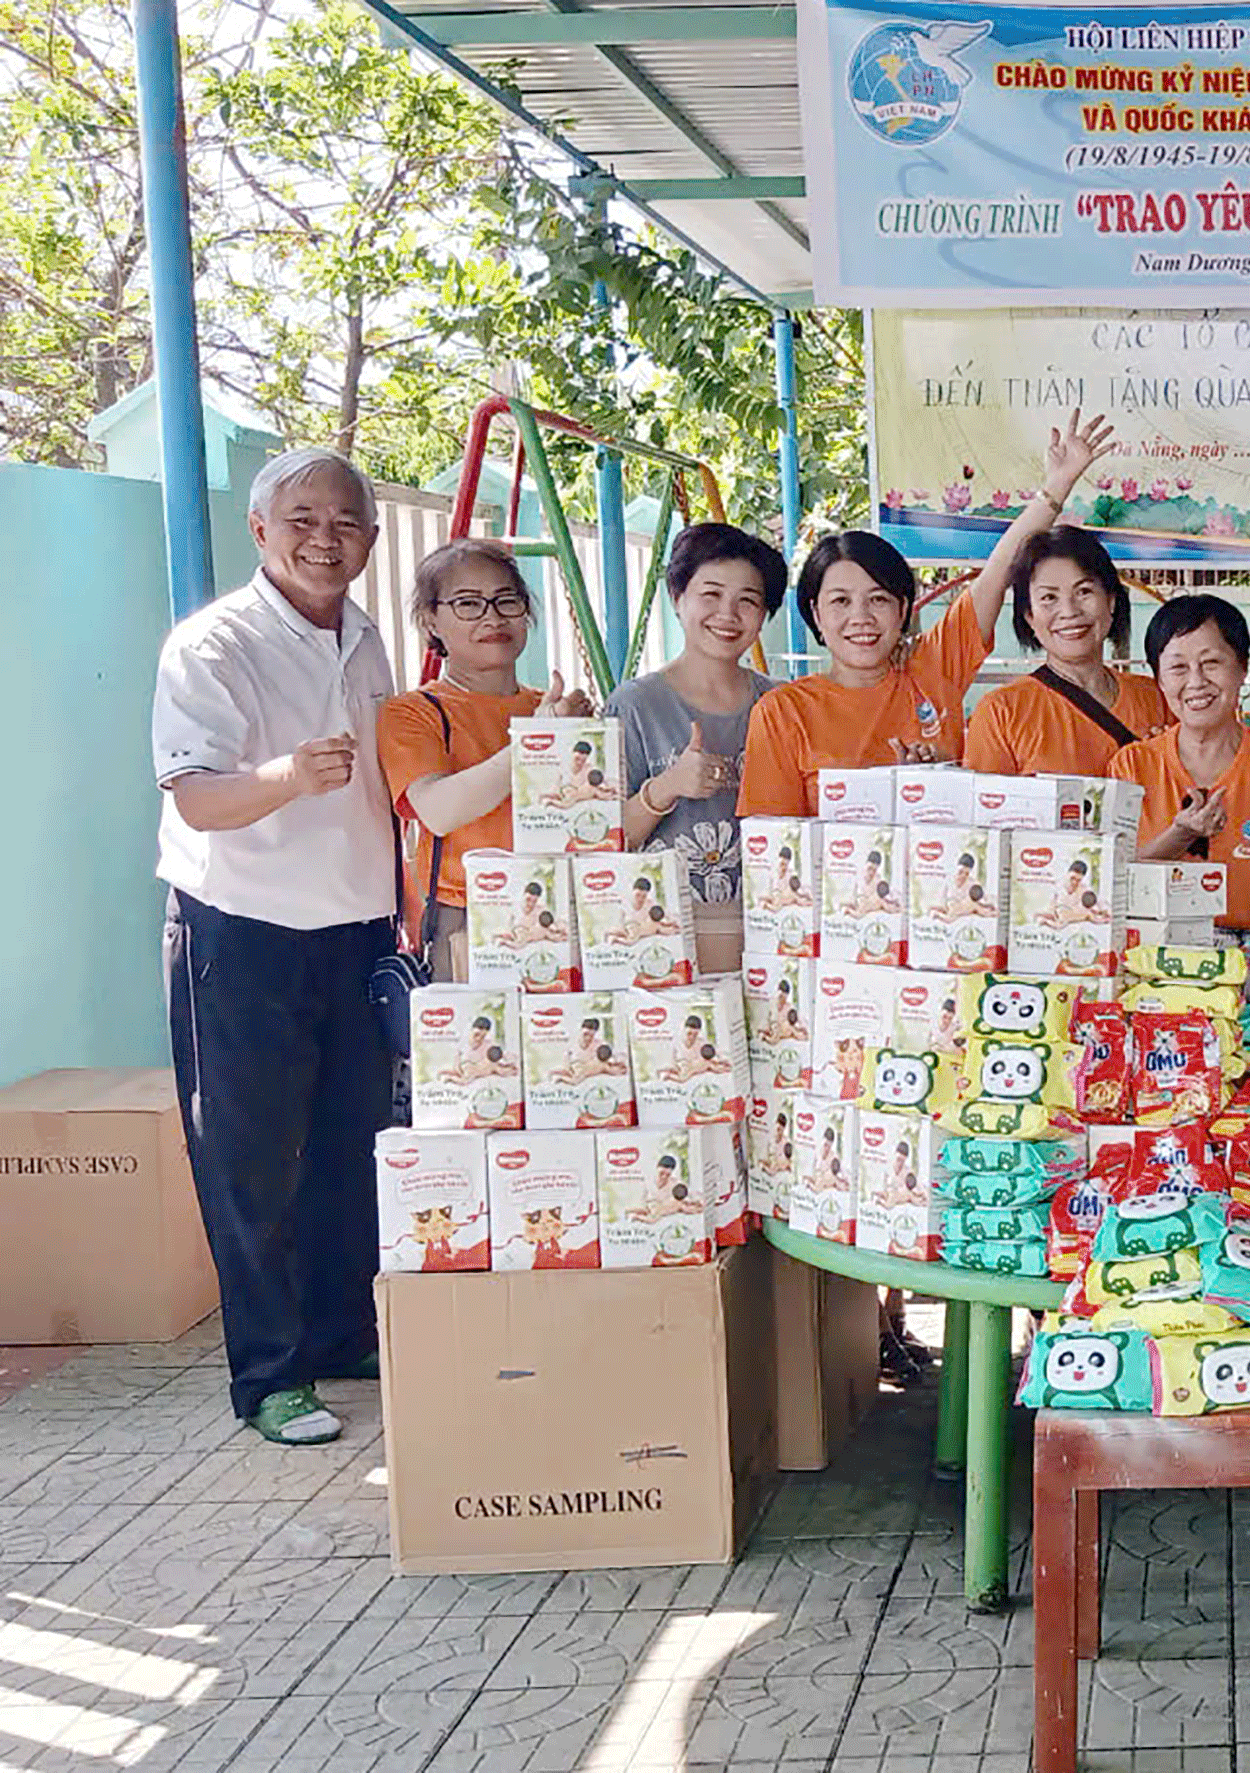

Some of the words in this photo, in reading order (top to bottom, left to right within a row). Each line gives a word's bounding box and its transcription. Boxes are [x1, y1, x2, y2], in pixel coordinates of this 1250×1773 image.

[1067, 22, 1111, 52] HỘI
[1121, 21, 1179, 50] LIÊN
[1187, 21, 1246, 52] HIỆP
[996, 60, 1068, 89] CHÀO
[1075, 64, 1154, 93] MỪNG
[1160, 64, 1195, 94] KỶ
[1081, 101, 1117, 132] VÀ
[1124, 101, 1195, 133] QUỐC
[878, 199, 982, 234] CHƯƠNG
[984, 195, 1061, 234] TRÌNH
[1136, 253, 1182, 273] Nam
[917, 360, 985, 408] ĐẾN
[1190, 440, 1229, 462] ngày
[1146, 1050, 1187, 1071] OMO
[84, 1155, 139, 1175] CASE
[454, 1493, 523, 1520] CASE
[527, 1486, 663, 1519] SAMPLING
